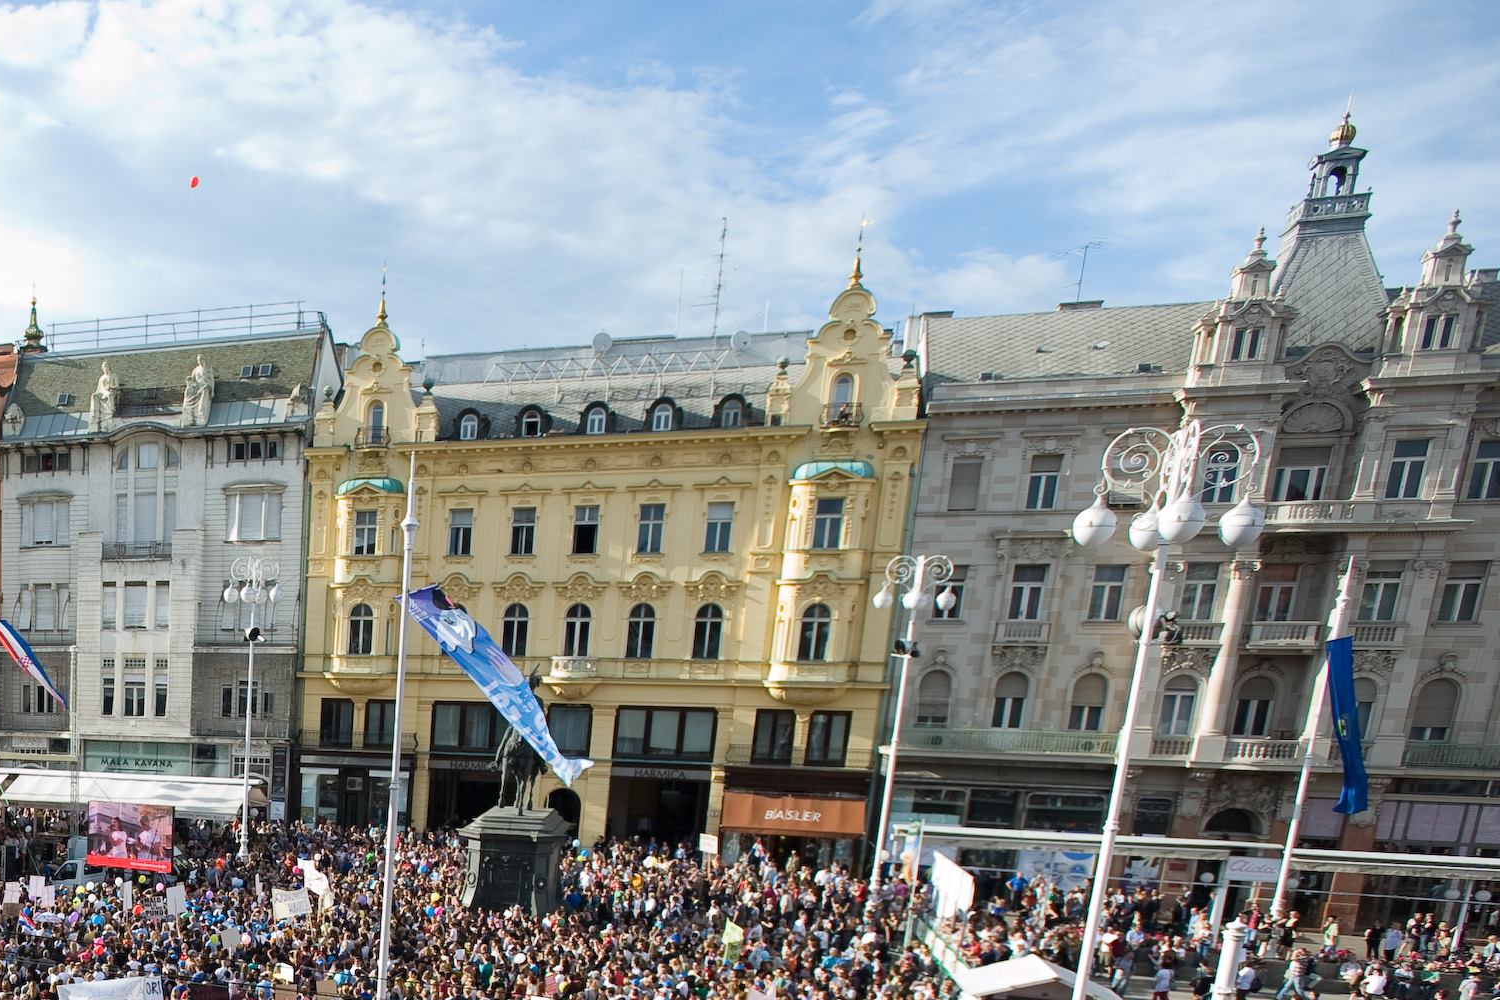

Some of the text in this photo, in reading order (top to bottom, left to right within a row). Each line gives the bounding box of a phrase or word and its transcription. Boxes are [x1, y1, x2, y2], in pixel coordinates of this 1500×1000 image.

[101, 757, 173, 768] MALA KAVANA
[634, 768, 686, 780] HARMICA
[764, 808, 822, 822] BASLER
